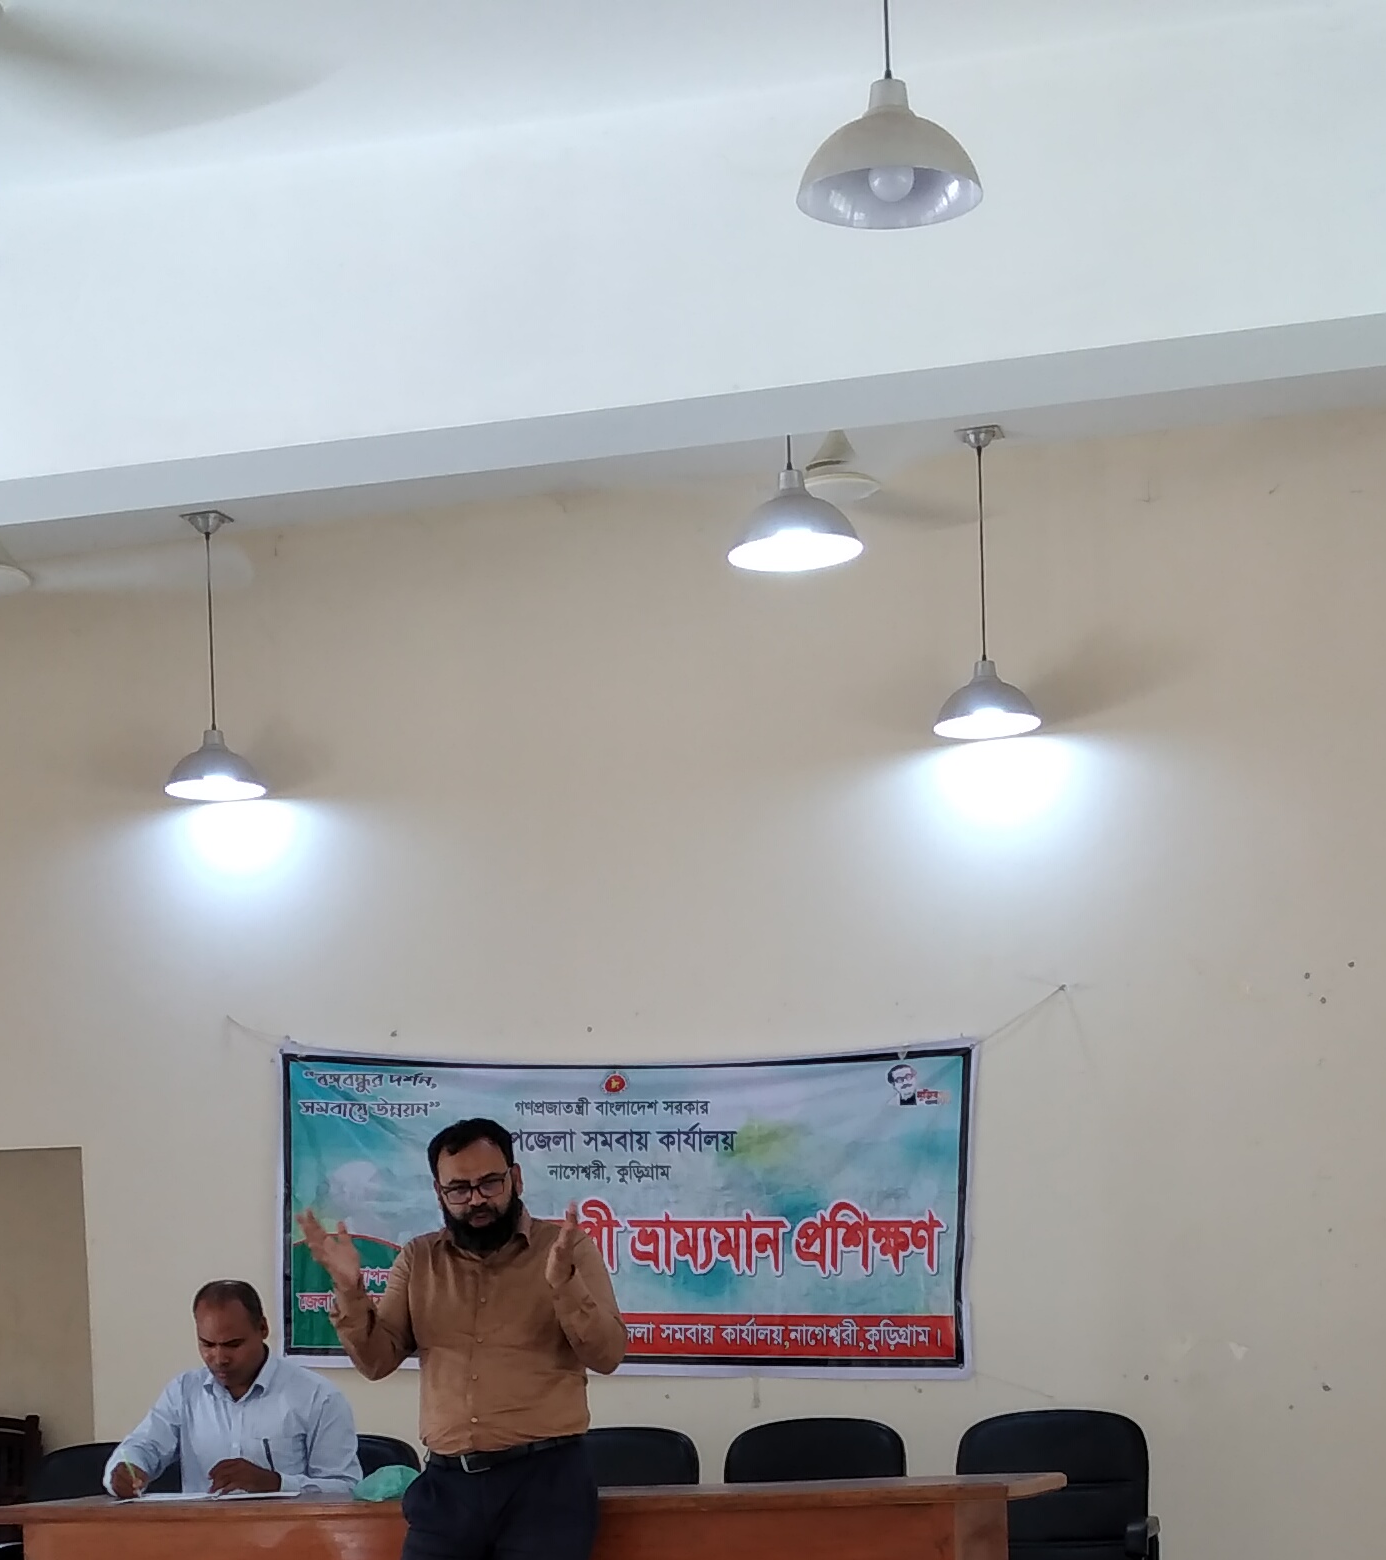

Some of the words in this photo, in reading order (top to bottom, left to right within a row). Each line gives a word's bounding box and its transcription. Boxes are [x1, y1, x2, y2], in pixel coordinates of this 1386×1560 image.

[389, 1072, 438, 1090] দর্শন,
[514, 1096, 592, 1117] গণপ্রজাতন্ত্রী
[594, 1099, 658, 1116] বাংলাদেশ
[662, 1099, 711, 1116] সরকার
[511, 1128, 577, 1153] পজেলা
[581, 1128, 652, 1153] সমবায়
[655, 1122, 738, 1153] কার্যালয়
[547, 1159, 611, 1184] নাগেশ্বরী,
[614, 1160, 672, 1185] কুড়িগ্রাম
[626, 1210, 788, 1277] ভ্রাম্যমান
[794, 1200, 944, 1278] প্রশিক্ষণ
[296, 1290, 335, 1312] জেলা
[660, 1323, 715, 1346] সমবায়
